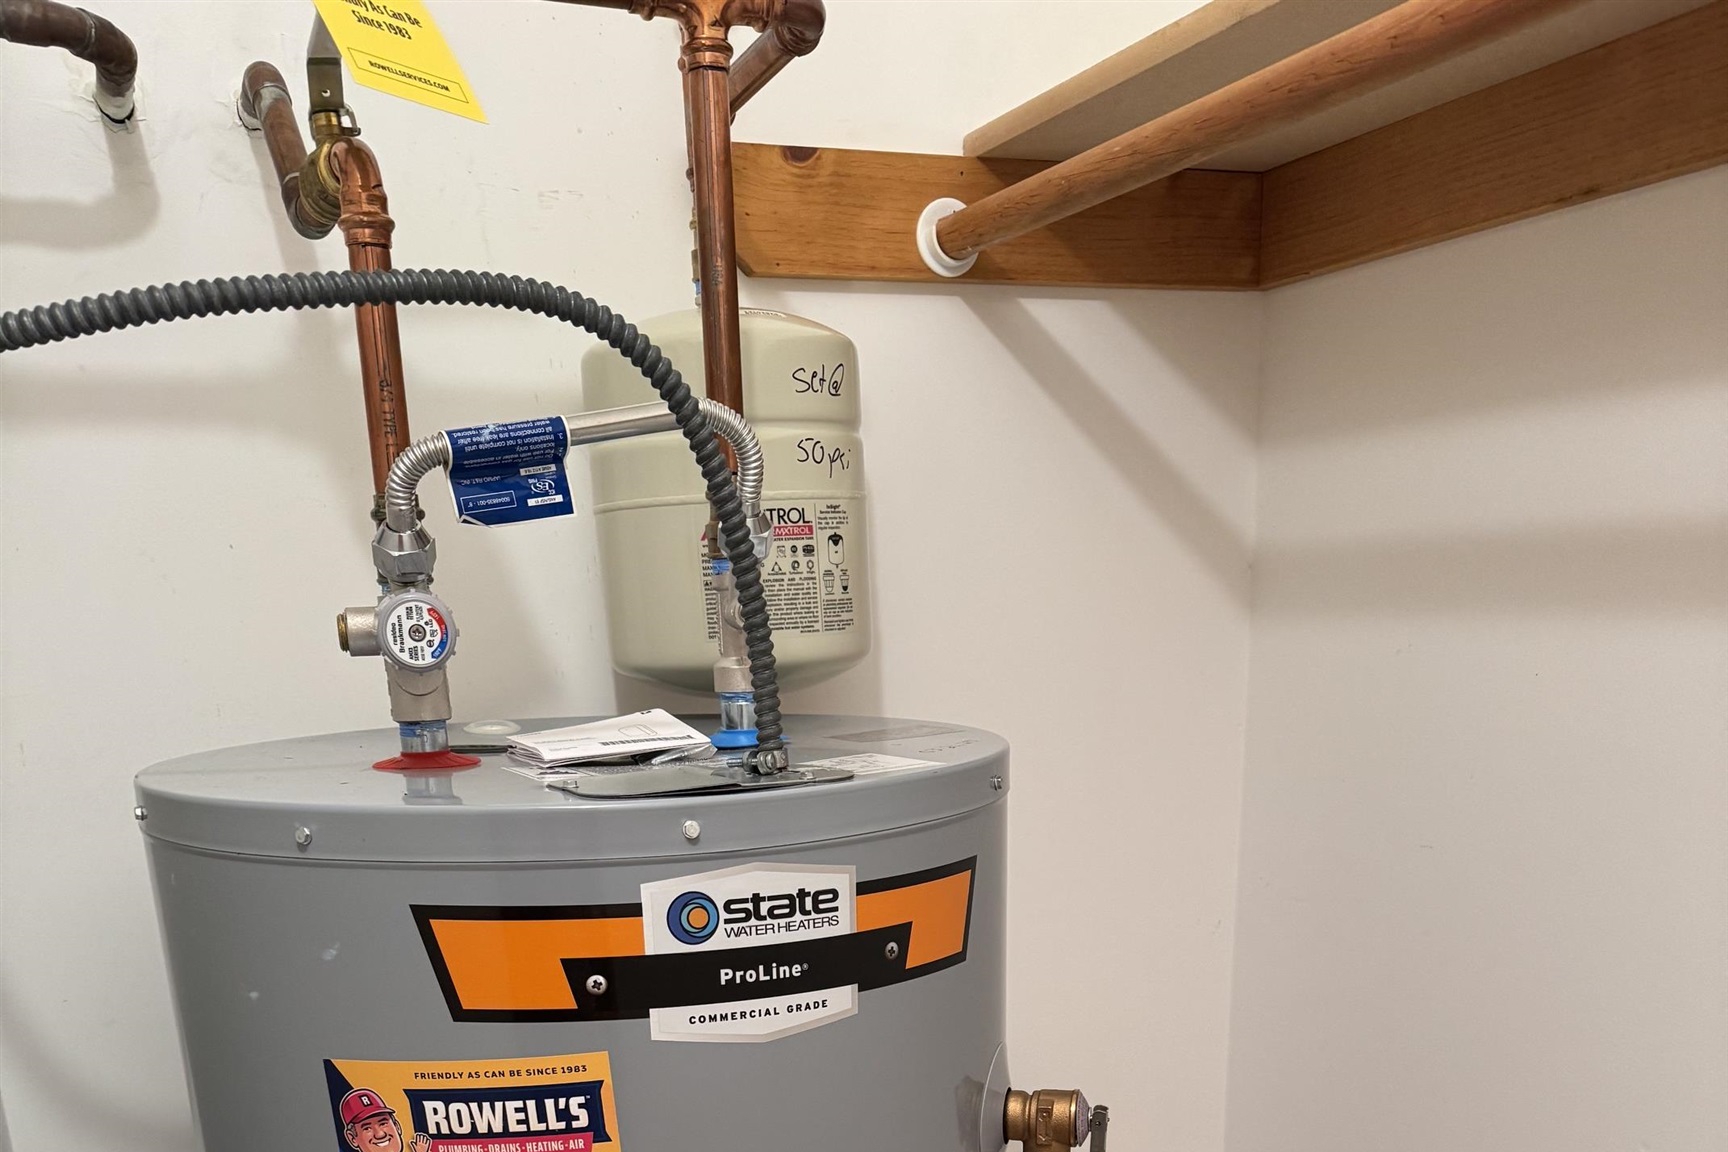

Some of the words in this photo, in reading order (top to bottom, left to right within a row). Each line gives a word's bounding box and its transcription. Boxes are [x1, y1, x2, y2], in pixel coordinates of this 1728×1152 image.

[383, 5, 407, 23] Can
[404, 12, 422, 28] Be
[351, 10, 385, 31] Since
[382, 21, 412, 40] 1983
[368, 60, 450, 92] ROWELLSERVICES.COM
[383, 409, 397, 437] TYPE
[507, 421, 533, 430] pressure
[452, 429, 478, 438] restored.
[510, 427, 545, 437] connections
[523, 434, 554, 444] Installation
[457, 437, 471, 445] after
[479, 440, 505, 449] complete
[529, 442, 555, 450] locations
[536, 481, 549, 491] ES
[764, 508, 813, 524] TROL
[397, 615, 405, 653] Braukmann
[723, 888, 839, 925] state
[724, 923, 776, 939] WATER
[777, 915, 839, 934] HEATERS
[689, 1006, 780, 1025] COMMERCIAL
[786, 999, 828, 1014] GRADE
[414, 1070, 464, 1080] FRIENDLY
[467, 1070, 481, 1079] AS
[484, 1069, 505, 1078] CAN
[509, 1069, 523, 1077] BE
[525, 1066, 558, 1077] SINCE
[560, 1064, 588, 1074] 1983
